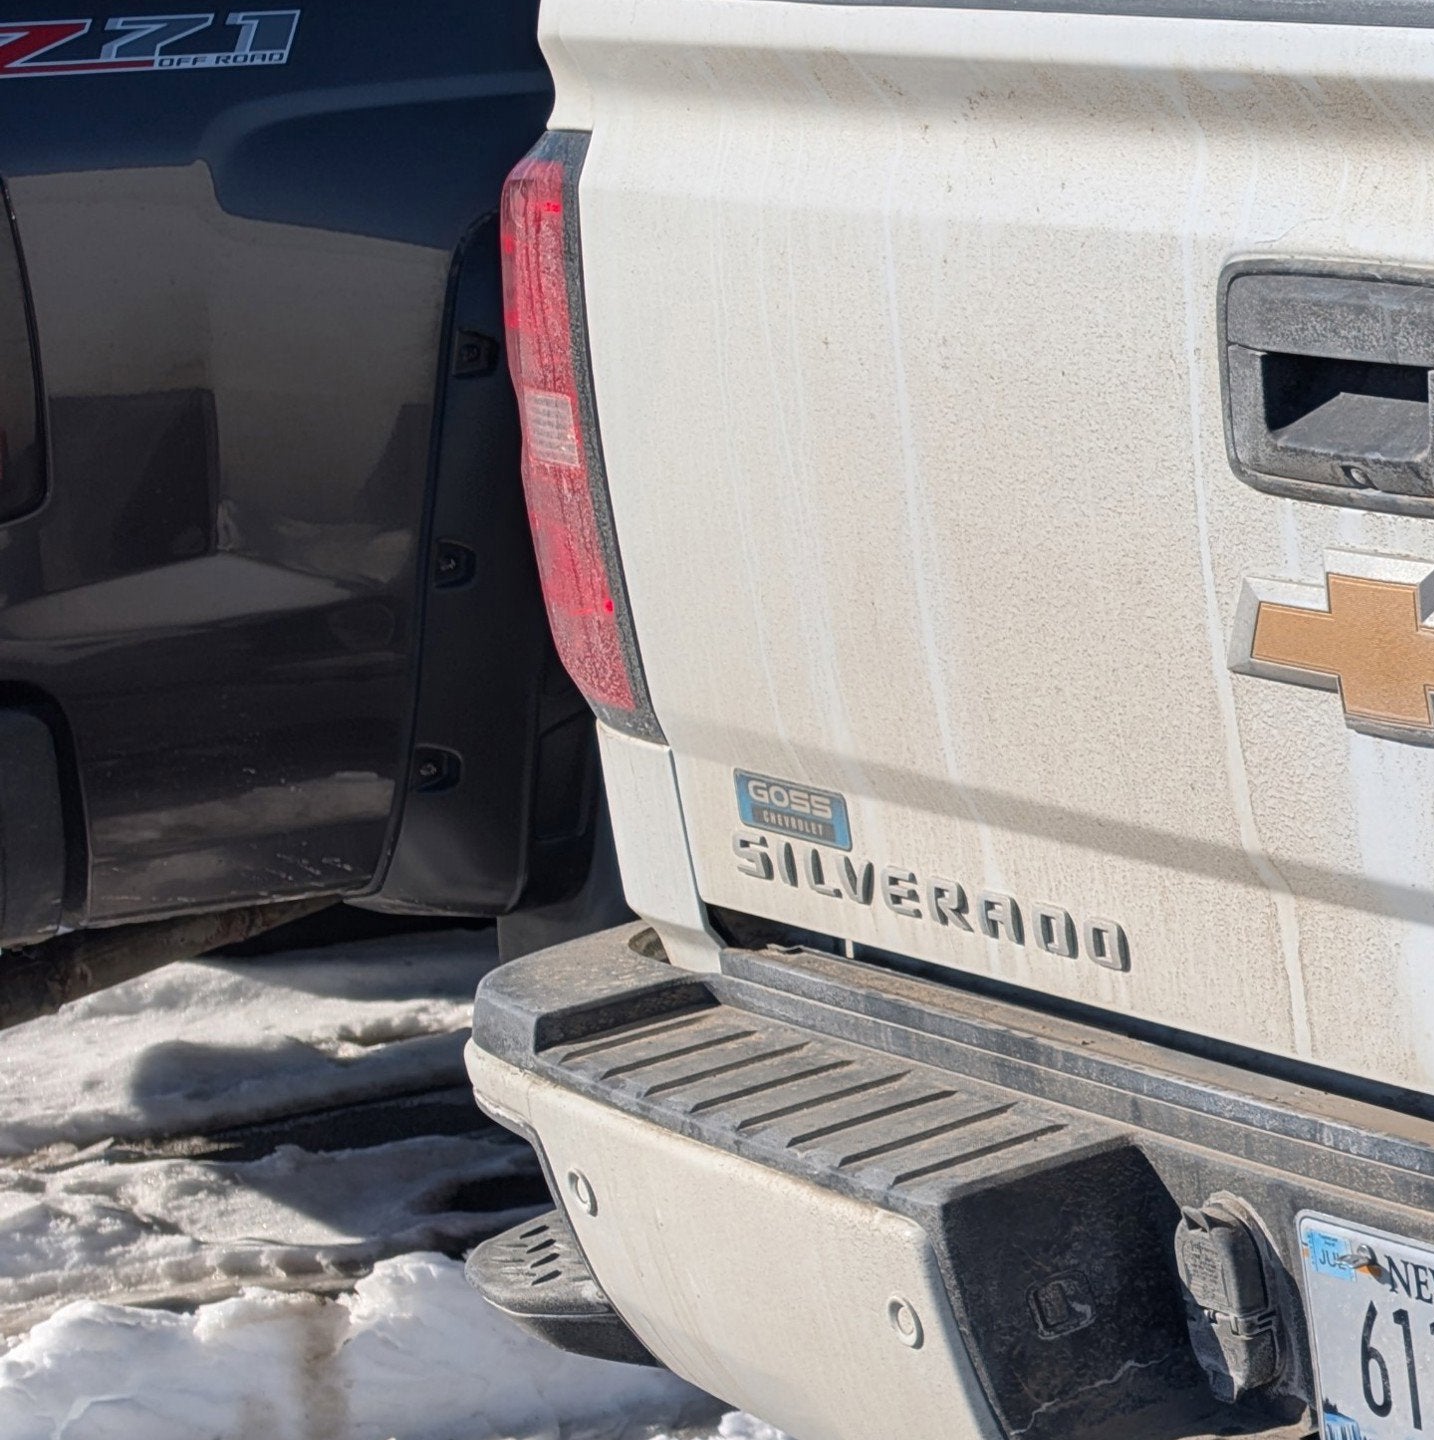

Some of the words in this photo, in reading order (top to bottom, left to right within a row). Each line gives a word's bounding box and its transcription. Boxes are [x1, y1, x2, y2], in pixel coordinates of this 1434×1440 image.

[158, 54, 208, 67] OFF
[214, 52, 285, 65] ROAD
[748, 779, 833, 820] GOSS
[762, 809, 824, 837] CHEVROLET
[732, 831, 1132, 973] SILVERADO
